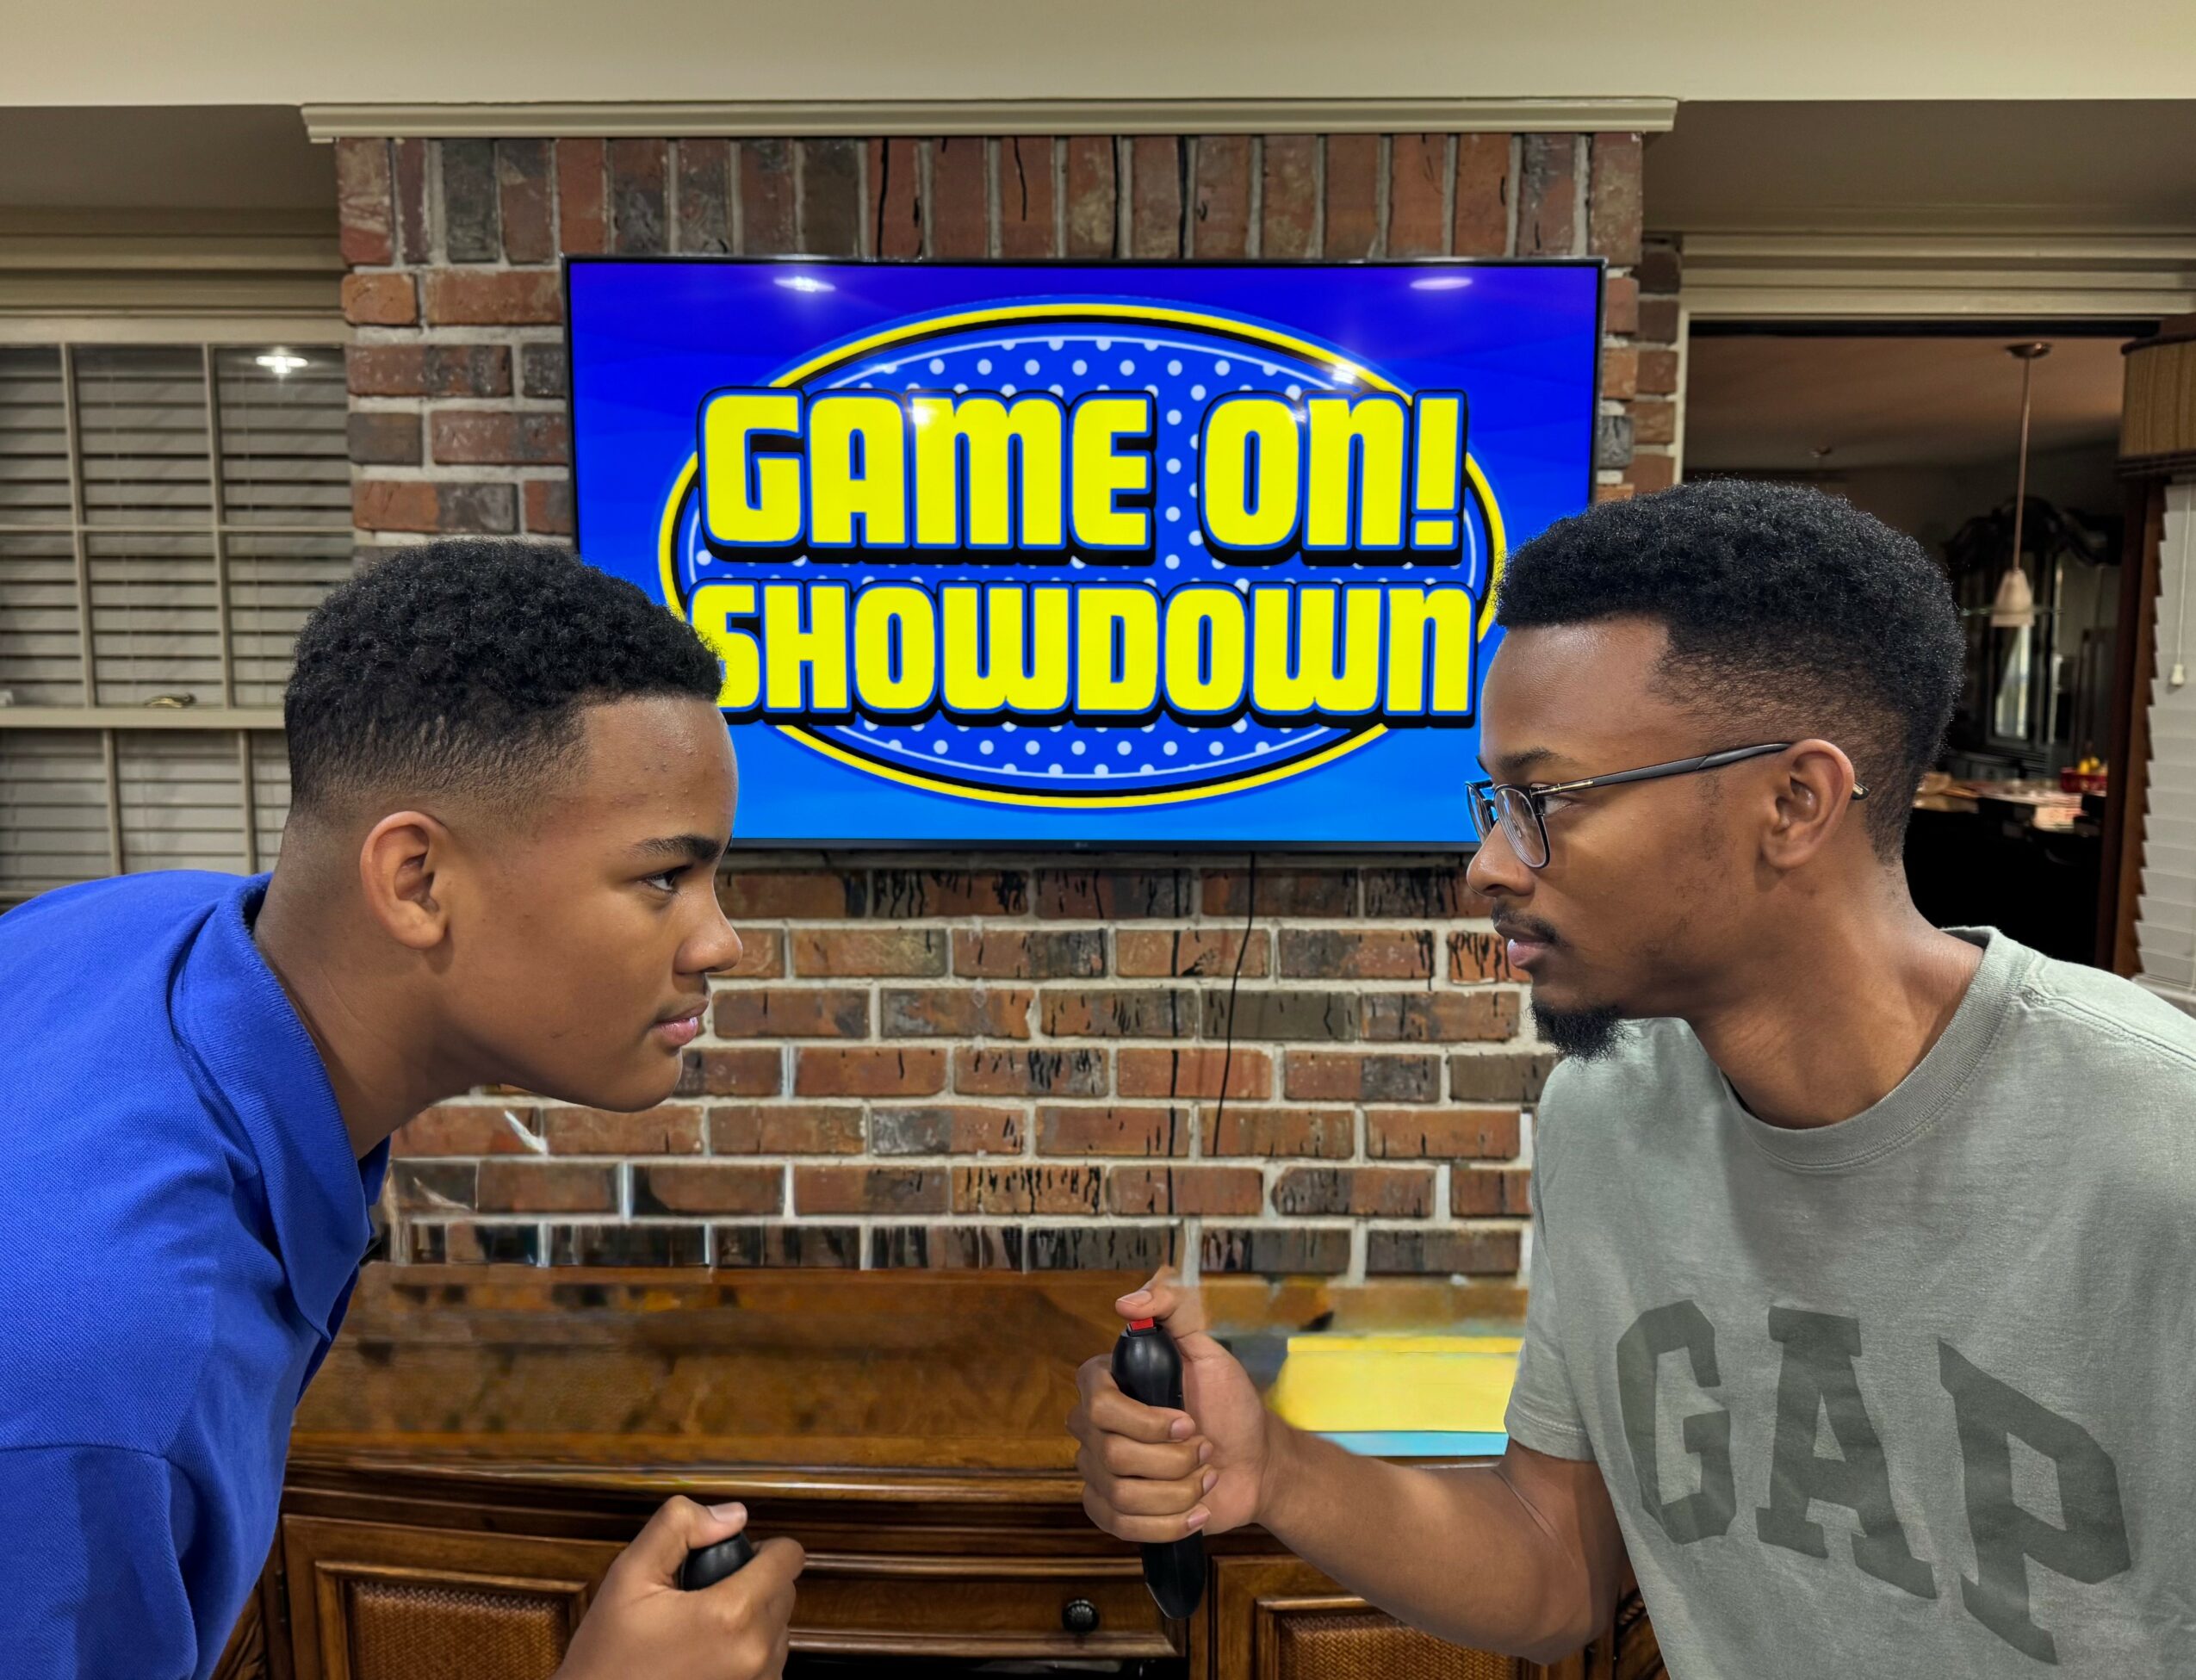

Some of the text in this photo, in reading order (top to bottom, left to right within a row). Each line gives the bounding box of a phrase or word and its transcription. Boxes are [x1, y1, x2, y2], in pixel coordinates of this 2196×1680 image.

[703, 394, 1462, 555] GAME ON!
[690, 582, 1473, 716] SHOWDOWN
[1616, 1299, 2131, 1666] GAP
